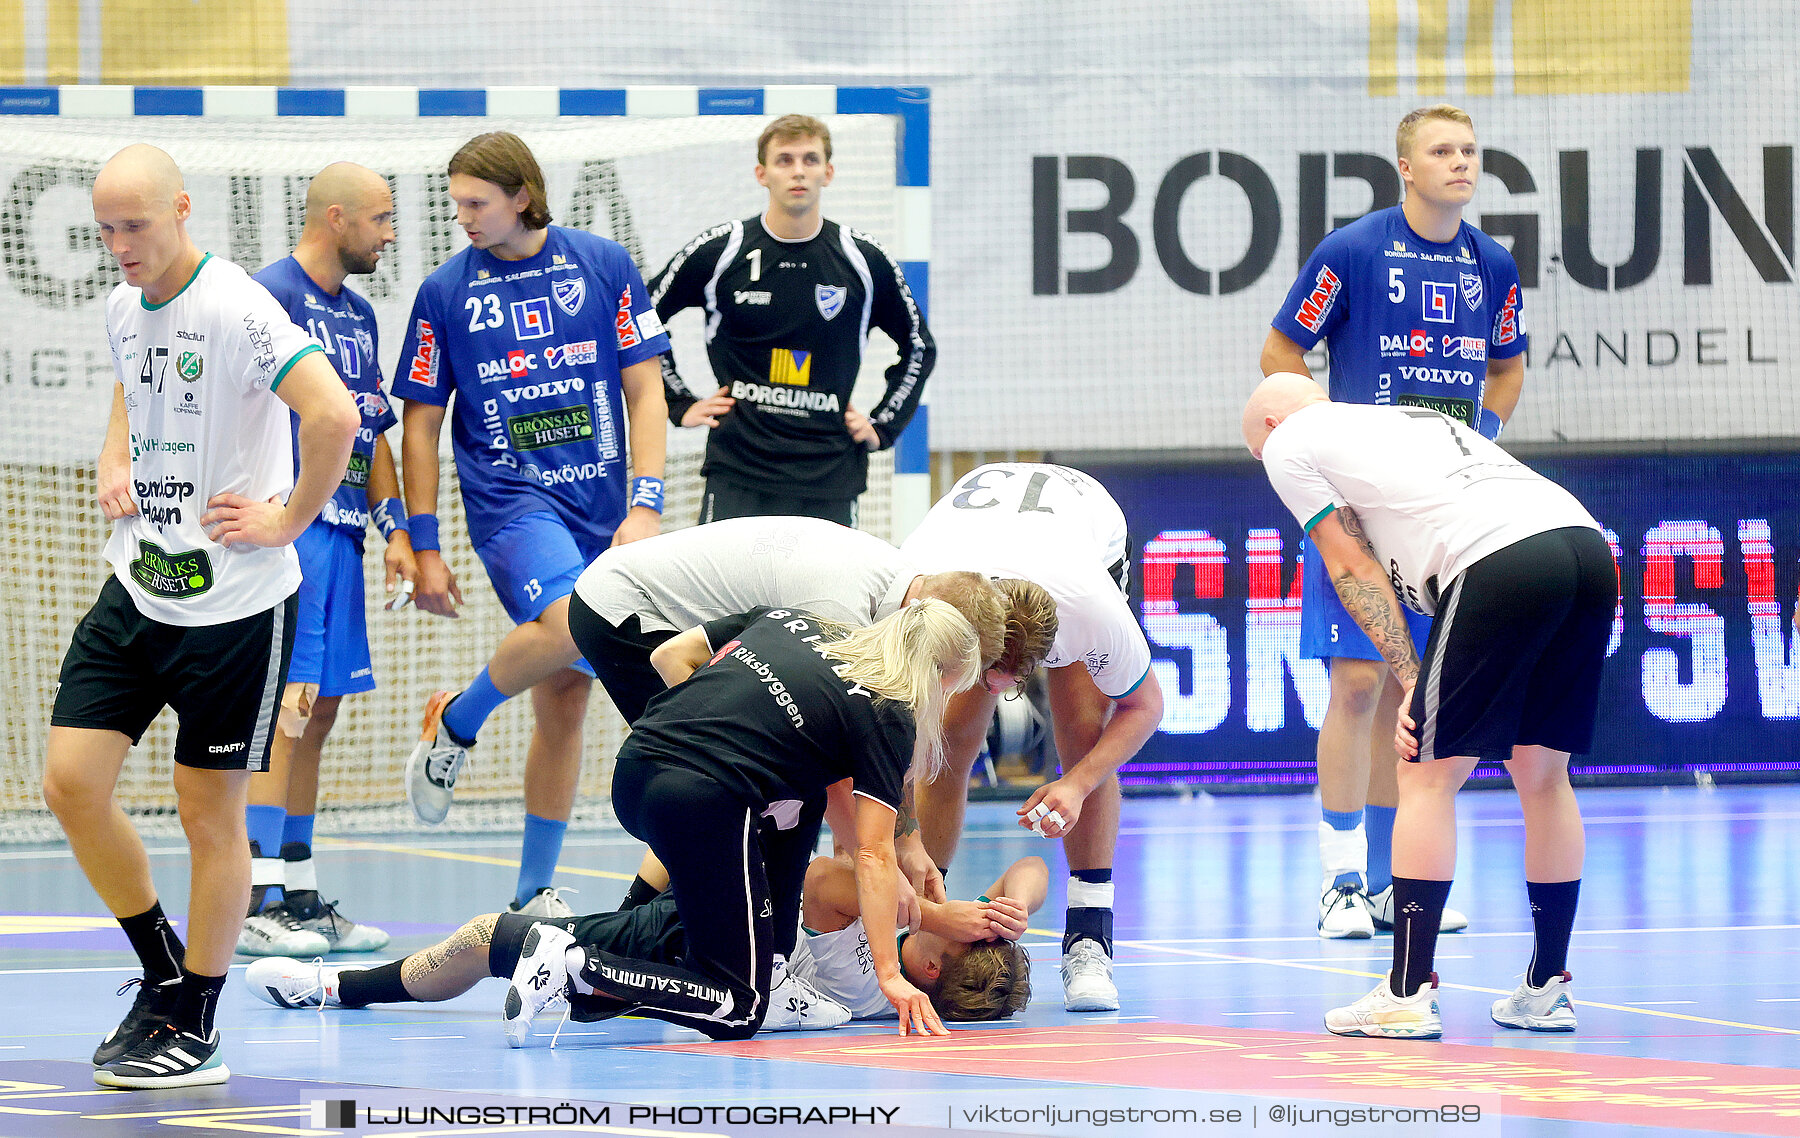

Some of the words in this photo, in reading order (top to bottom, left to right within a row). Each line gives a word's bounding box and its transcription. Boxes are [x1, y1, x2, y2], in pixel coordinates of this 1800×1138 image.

[746, 249, 762, 281] 1
[1297, 270, 1339, 329] MAXI
[1388, 267, 1405, 304] 5
[464, 293, 505, 333] 23
[410, 322, 435, 381] MAXI
[566, 353, 595, 365] SPORT
[1380, 335, 1434, 354] DALOC
[1463, 337, 1485, 349] INTER
[140, 347, 169, 394] 47
[477, 353, 538, 380] DALOC
[566, 341, 595, 355] INTER
[501, 377, 585, 404] VOLVO
[1398, 366, 1474, 386] VOLVO
[731, 380, 840, 413] BORGUNDA
[513, 411, 589, 436] GRÖNSAKS
[535, 426, 581, 444] HUSET
[541, 462, 608, 487] SKÖVDE
[953, 469, 1055, 514] 13
[524, 578, 543, 602] 23
[1331, 623, 1339, 643] 5
[731, 647, 804, 729] Riksbyggen
[208, 742, 241, 754] CRAFT
